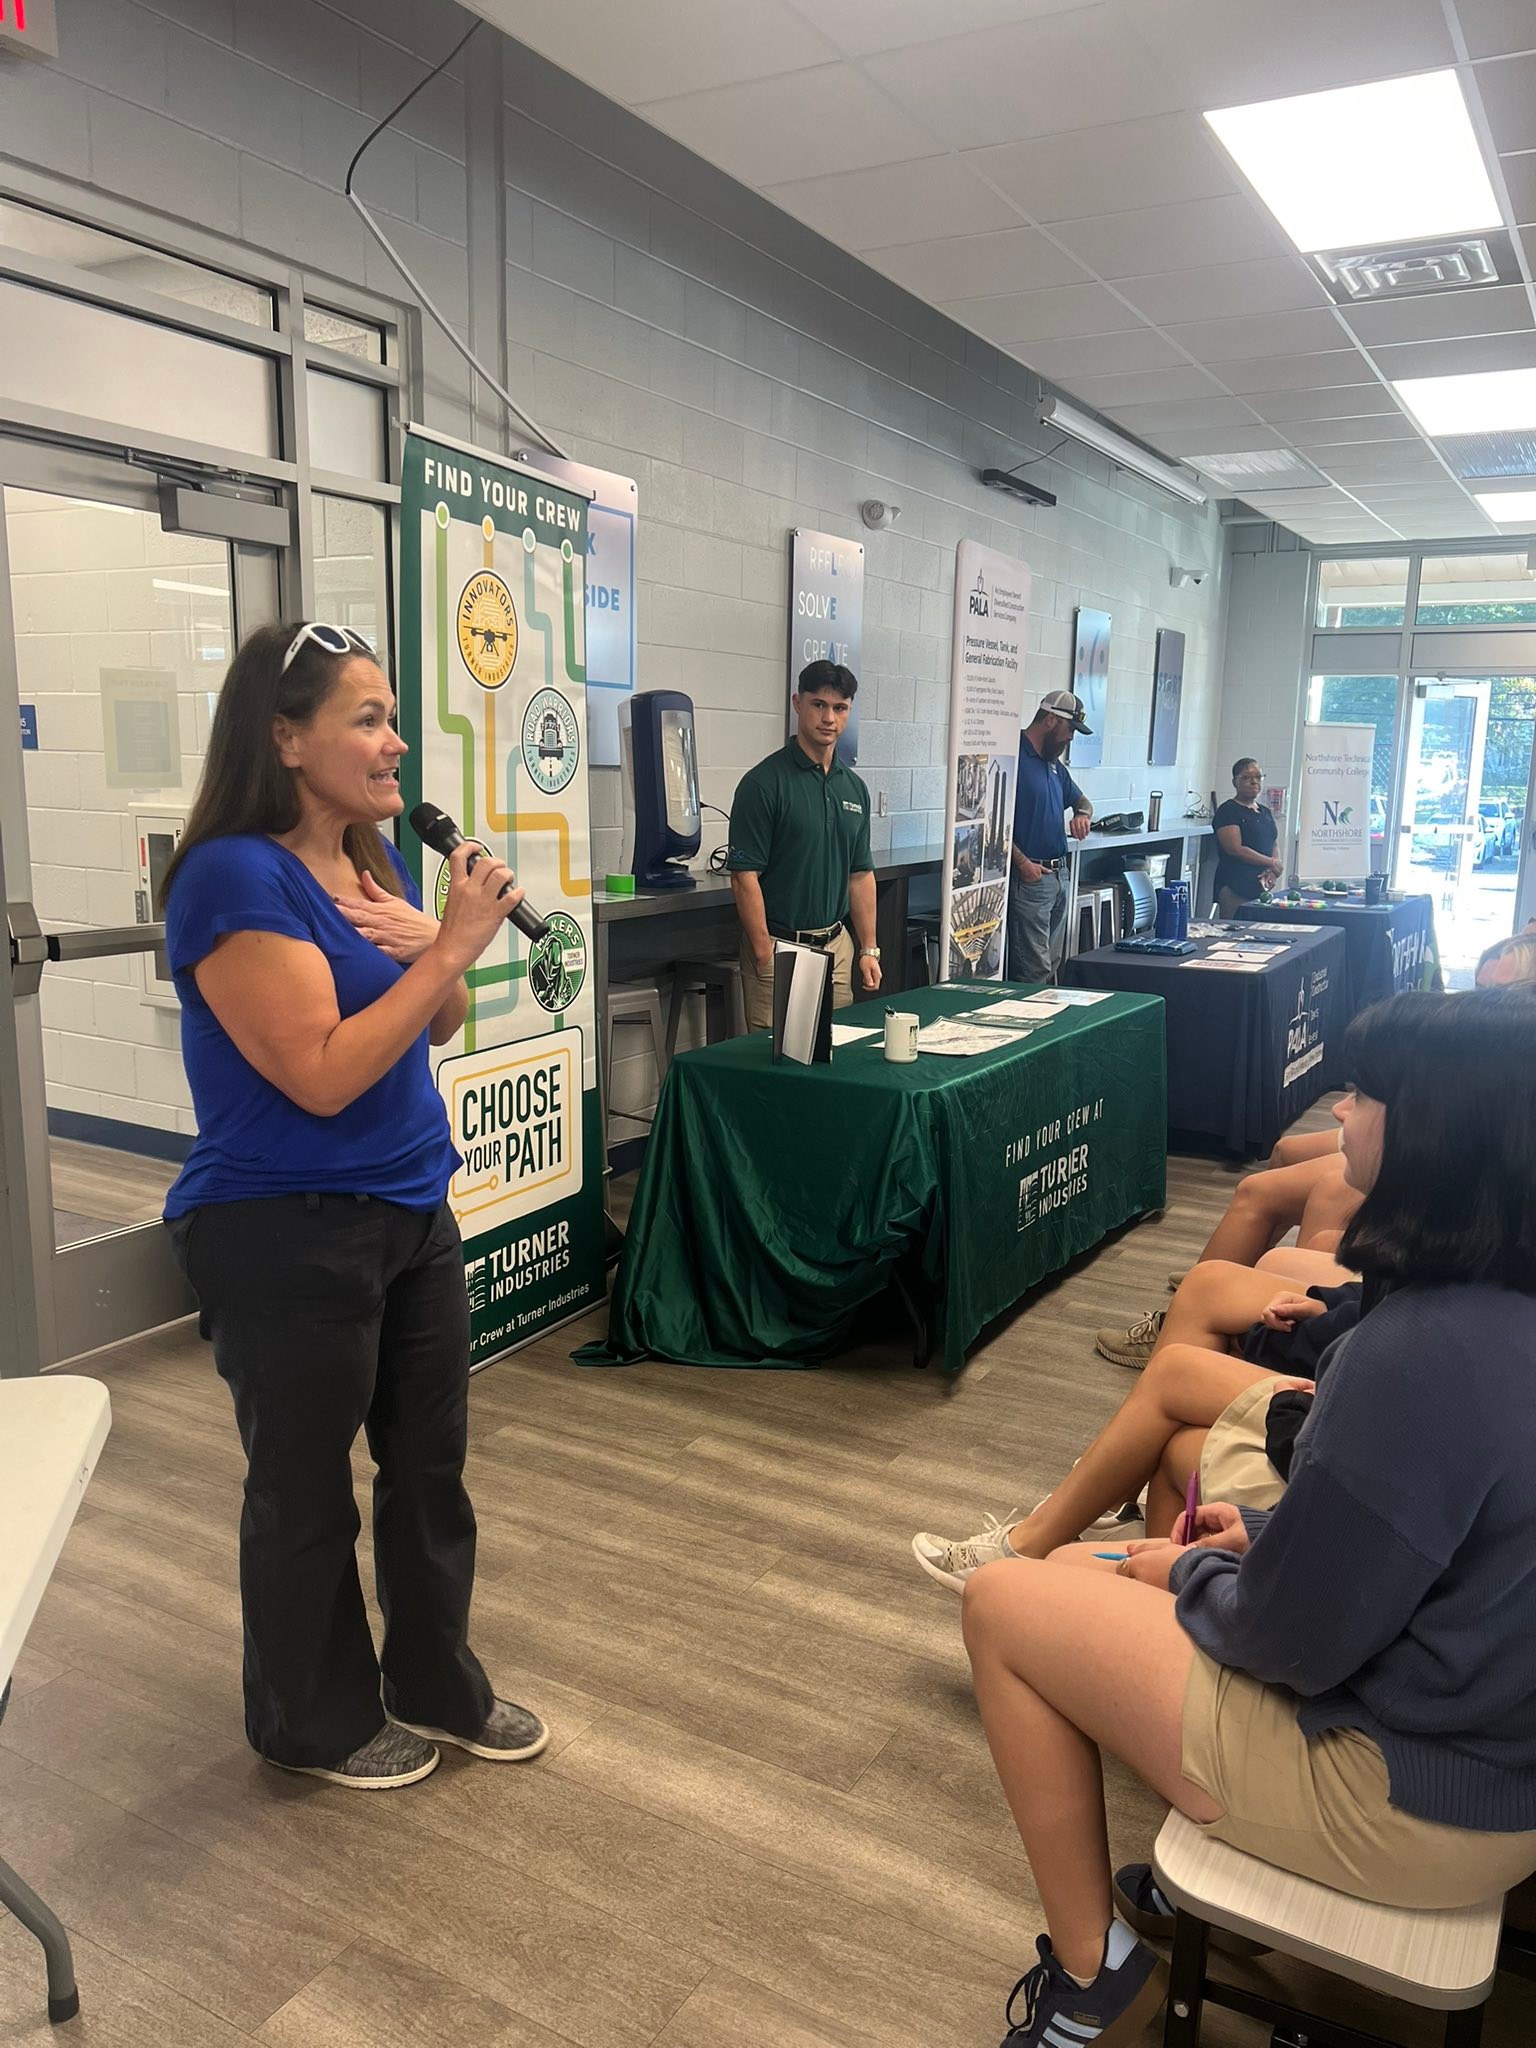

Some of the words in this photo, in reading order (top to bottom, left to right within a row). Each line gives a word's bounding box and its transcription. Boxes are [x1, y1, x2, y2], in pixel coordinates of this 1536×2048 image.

[424, 457, 473, 497] FIND
[480, 477, 528, 516] YOUR
[535, 496, 581, 532] CREW
[462, 579, 514, 626] INNOVATORS
[798, 590, 837, 620] SOLVE
[969, 595, 989, 618] PALA
[463, 637, 482, 675] TURNER
[485, 644, 514, 681] INDUSTRIES
[803, 638, 849, 667] CREATE
[965, 651, 982, 664] General
[983, 654, 1005, 668] Fabrication
[1005, 657, 1018, 672] Facility
[966, 635, 985, 648] Pressure
[986, 639, 998, 652] Vessel,
[1010, 644, 1018, 654] and
[526, 704, 541, 741] ROAD
[542, 696, 576, 743] WARRIORS
[1305, 753, 1342, 763] Northshore
[1343, 753, 1371, 763] Technica
[1307, 766, 1345, 777] Community
[1311, 829, 1362, 838] NORTHSHORE
[535, 919, 580, 951] MKERS
[461, 1063, 561, 1142] CHOOSE
[463, 1139, 502, 1177] YOUR
[505, 1116, 562, 1183] PATH
[1005, 1135, 1031, 1168] FIND
[1036, 1119, 1061, 1150] YOUR
[1094, 1098, 1104, 1121] AT
[488, 1220, 570, 1278] TURNER
[489, 1249, 571, 1303] INDUSTRIES
[480, 1326, 504, 1346] Crew
[505, 1318, 515, 1333] at
[517, 1304, 547, 1327] Turner
[548, 1282, 590, 1312] Industries
